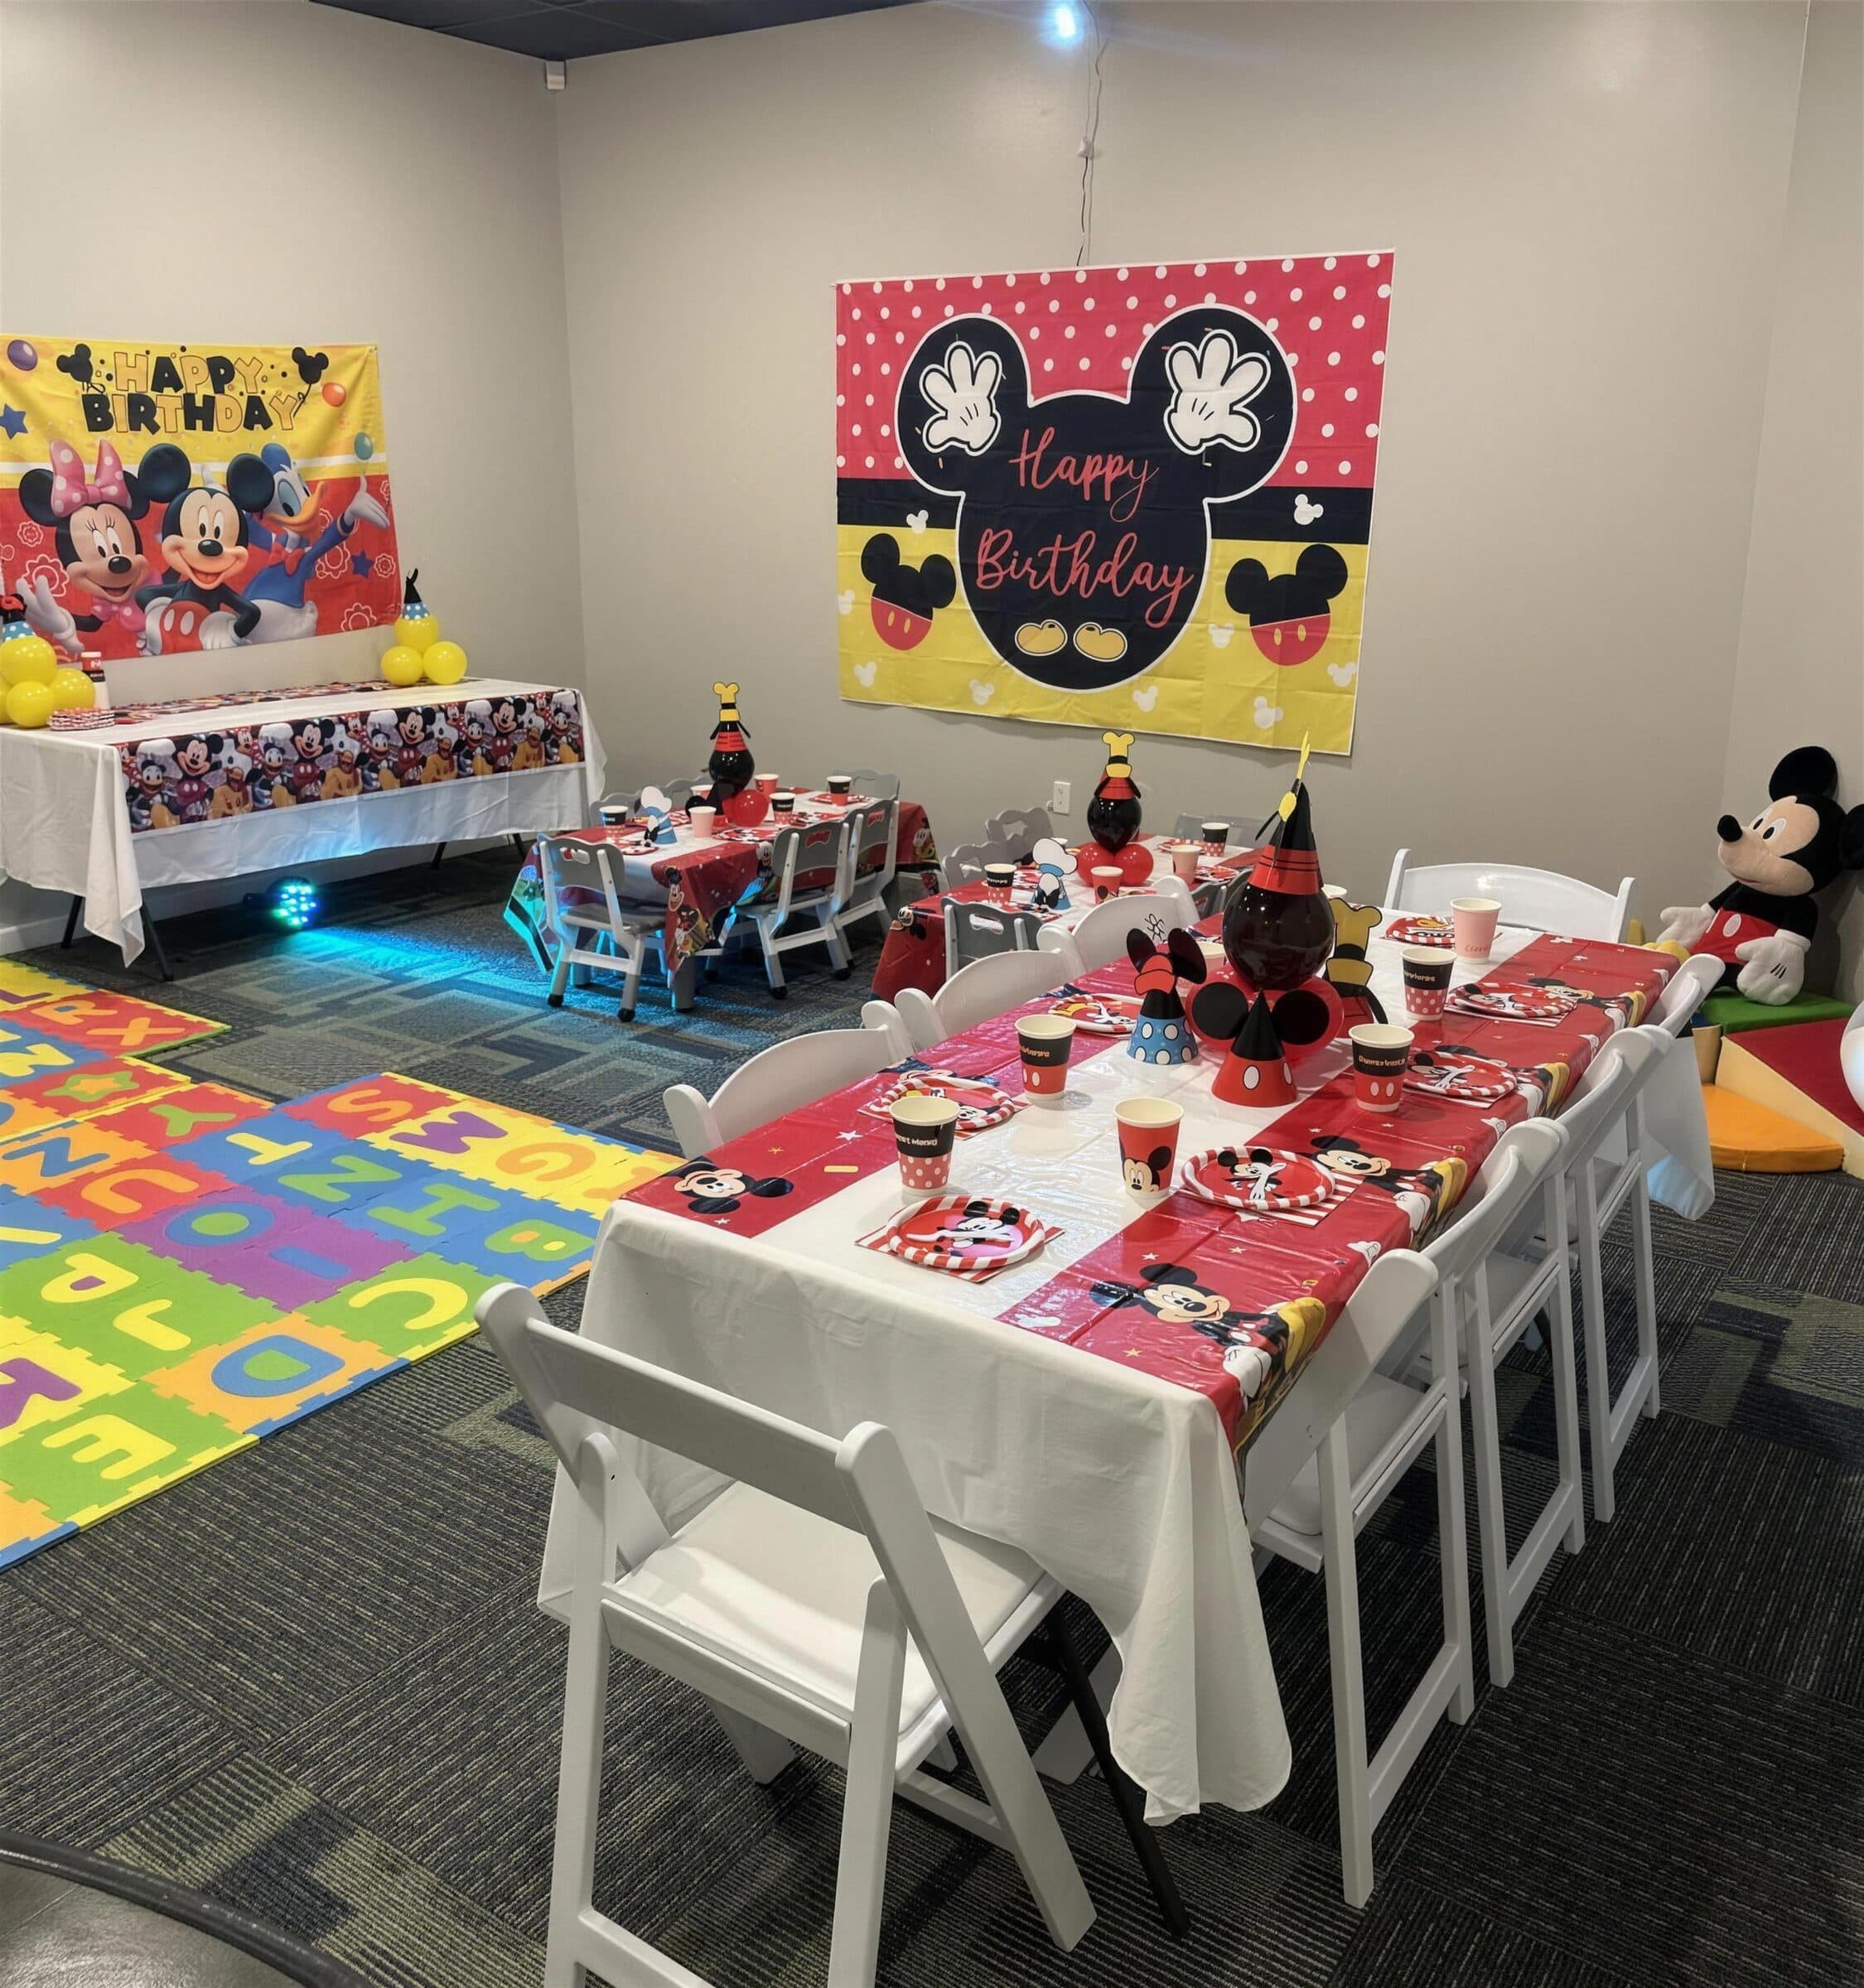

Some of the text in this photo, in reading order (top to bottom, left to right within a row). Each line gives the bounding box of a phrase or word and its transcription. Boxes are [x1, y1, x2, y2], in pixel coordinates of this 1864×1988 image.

[113, 352, 263, 394] HAPPY
[81, 393, 300, 435] BIRTHDAY
[1009, 427, 1159, 523] Happy
[977, 528, 1194, 628] Birthday
[86, 1017, 186, 1046] X
[147, 1103, 237, 1137] Y
[327, 1088, 413, 1122] S
[225, 1132, 313, 1165] T
[495, 1141, 596, 1181] G
[163, 1202, 276, 1247] O
[485, 1219, 597, 1262] B
[41, 1252, 139, 1304] P
[348, 1277, 469, 1330] C
[211, 1334, 345, 1397] D
[41, 1413, 176, 1480] E
